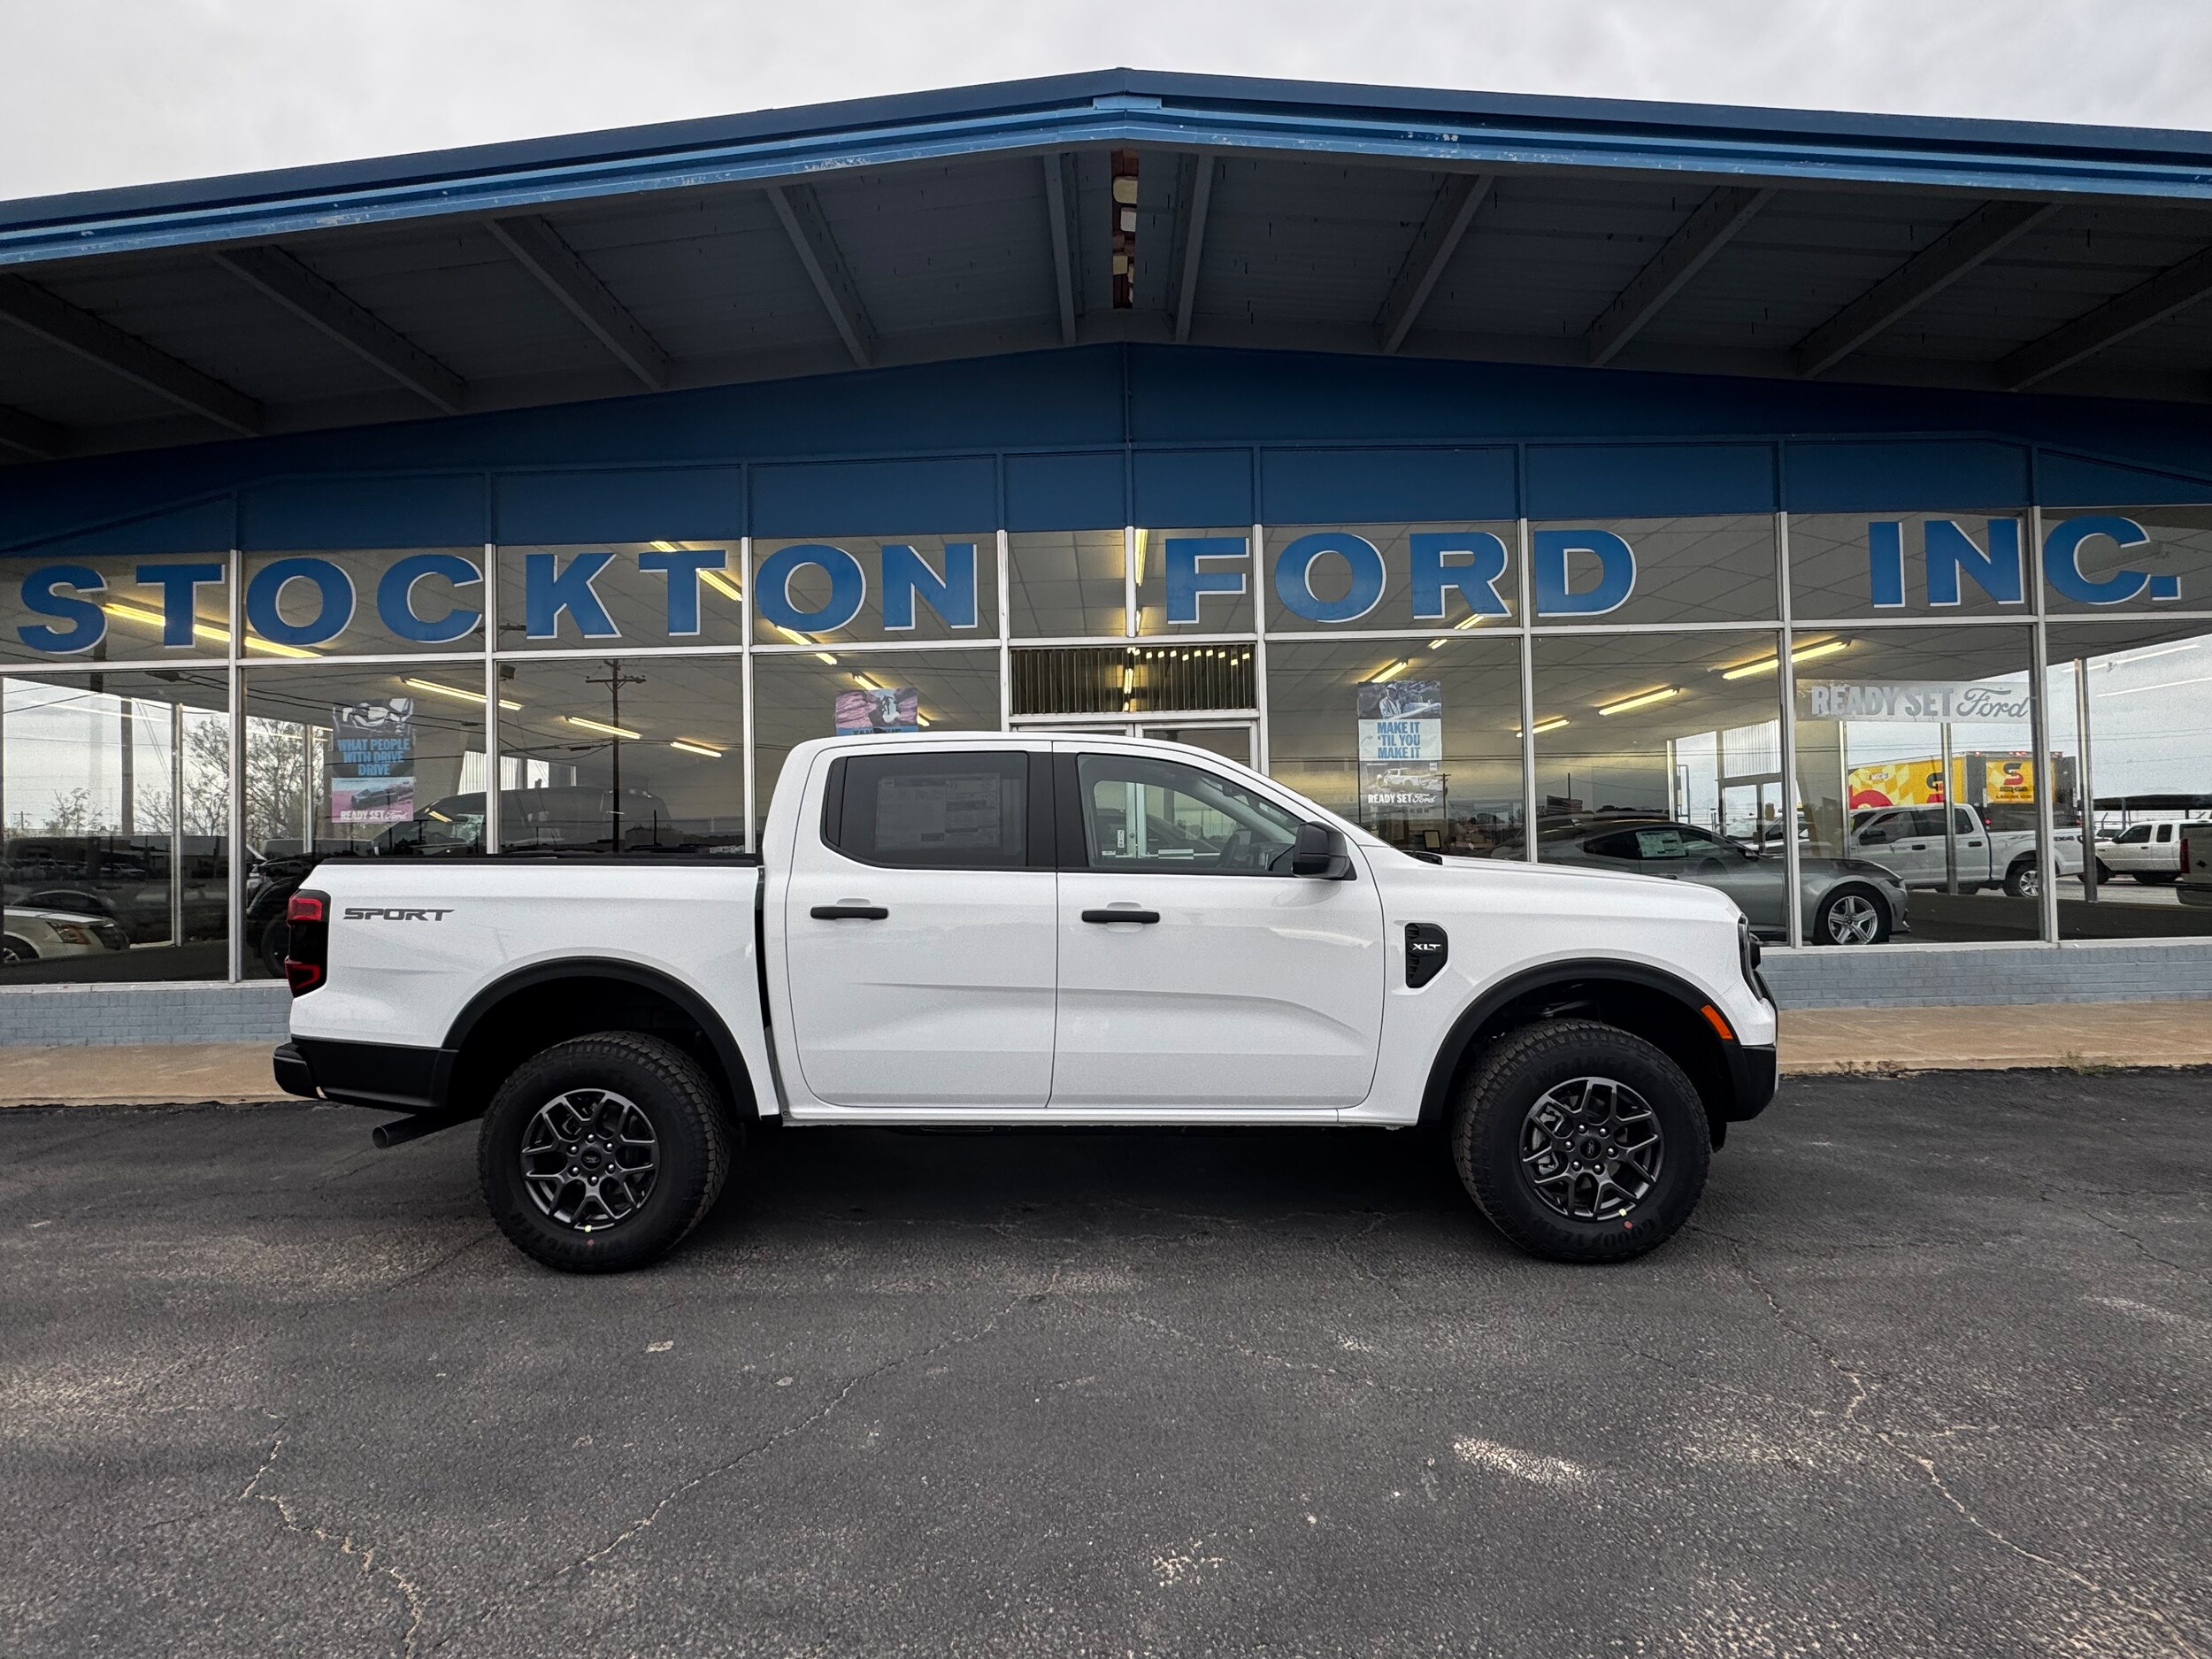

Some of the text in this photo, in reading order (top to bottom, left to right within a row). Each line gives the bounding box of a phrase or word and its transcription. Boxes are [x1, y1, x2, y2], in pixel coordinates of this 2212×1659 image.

[17, 515, 2183, 655] STOCKTON FORD INC.
[1811, 686, 2031, 718] READY SET Ford
[1377, 721, 1421, 733] MAKE IT
[337, 738, 411, 751] WHAT PEOPLE
[1399, 734, 1421, 746] YOU
[343, 750, 404, 764] WITH DRIVE
[1378, 747, 1421, 758] MAKE IT
[358, 764, 390, 776] DRIVE
[1367, 793, 1436, 803] READY SET Ford
[340, 810, 369, 820] READY
[368, 810, 386, 820] SET
[342, 908, 455, 921] SPORT
